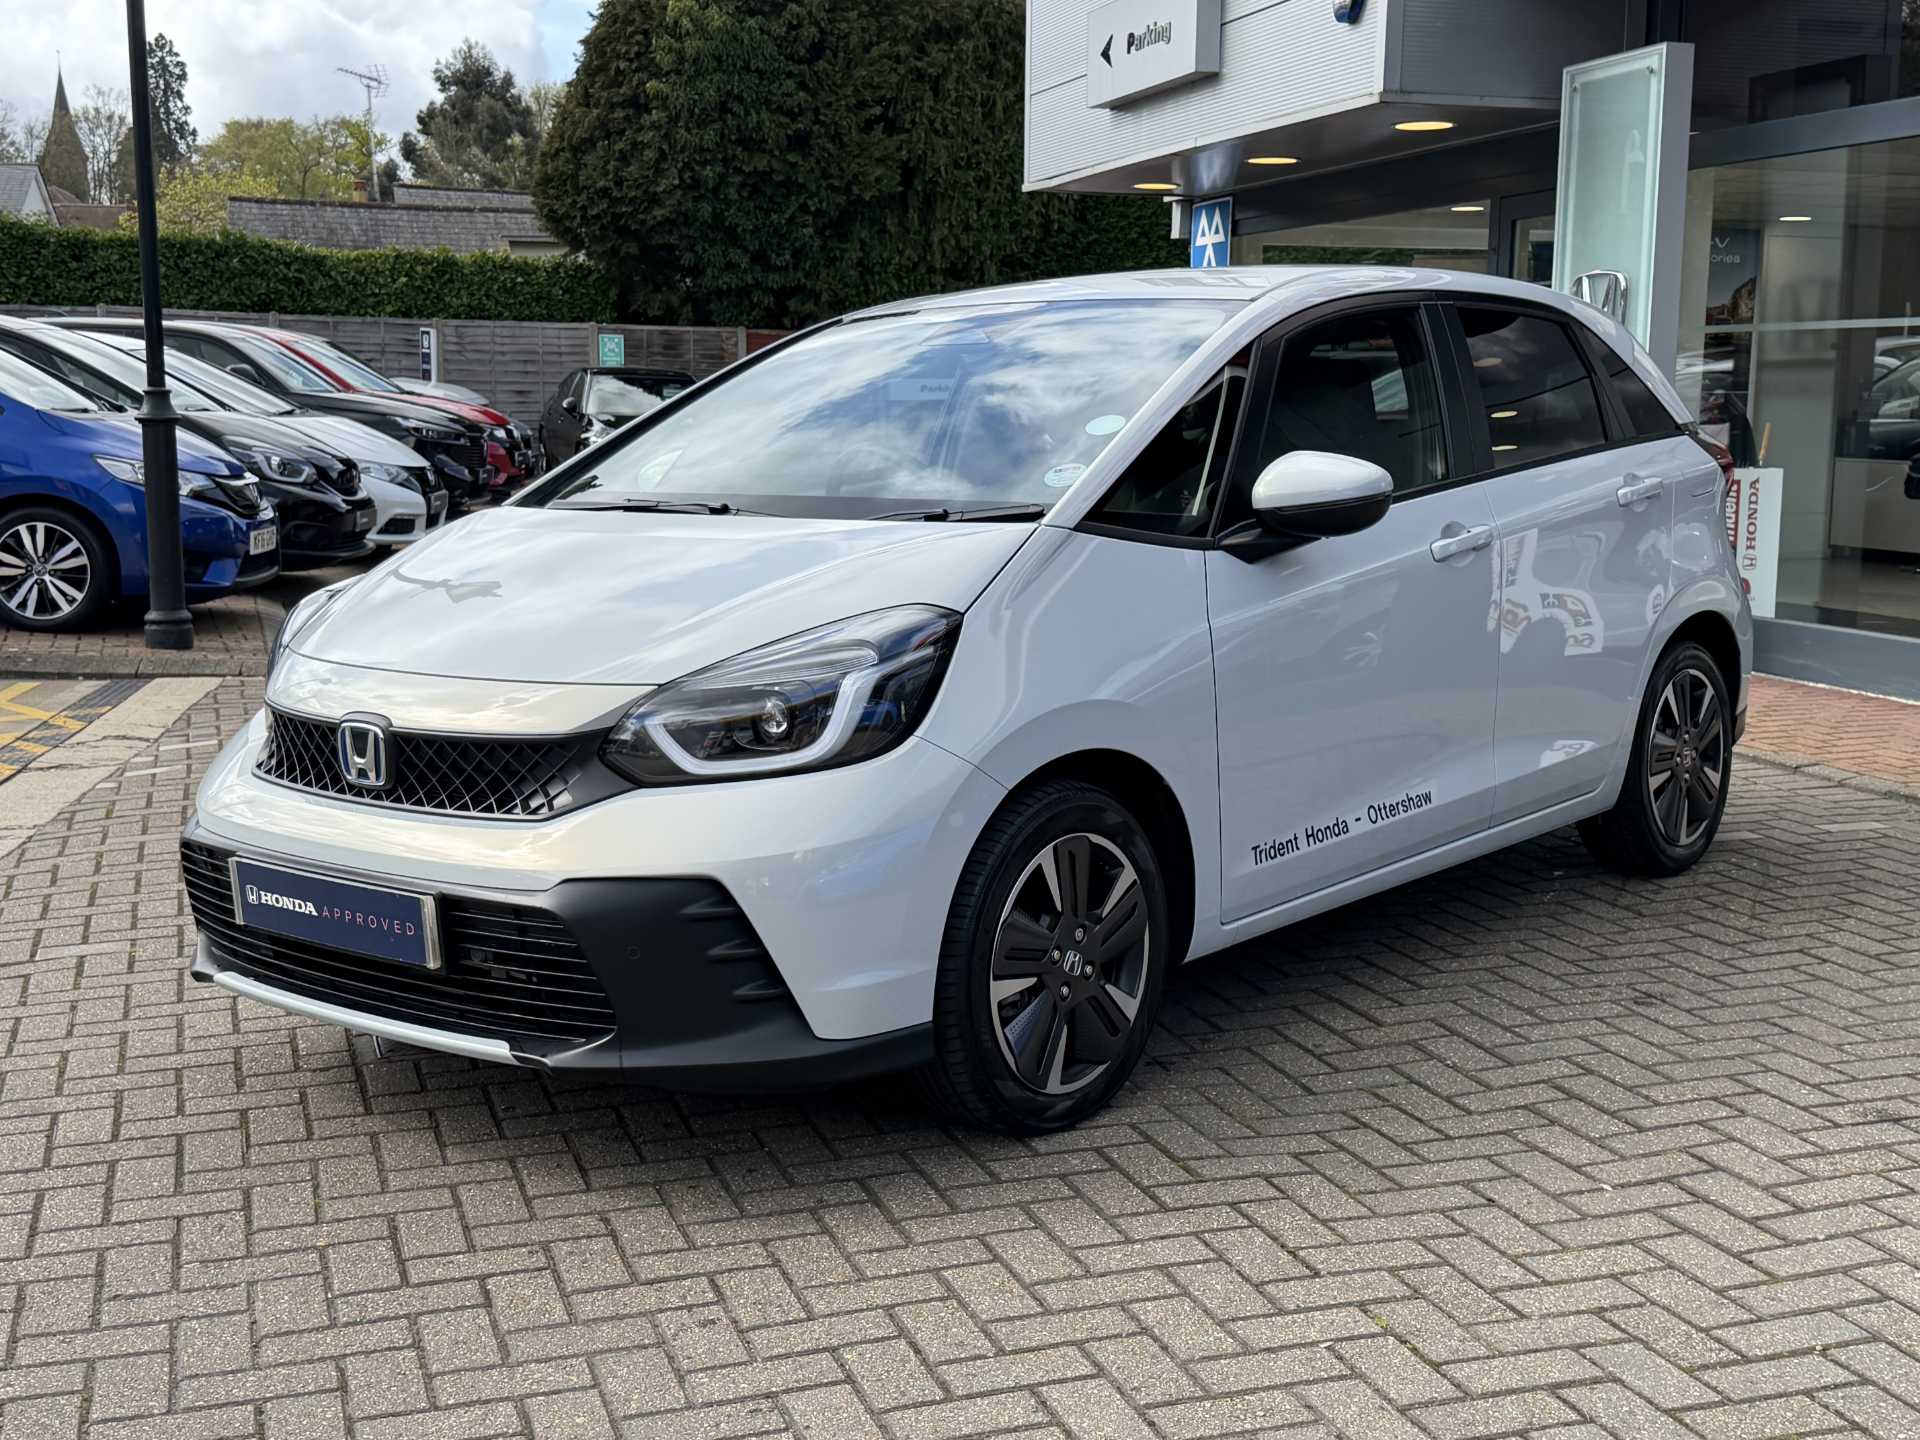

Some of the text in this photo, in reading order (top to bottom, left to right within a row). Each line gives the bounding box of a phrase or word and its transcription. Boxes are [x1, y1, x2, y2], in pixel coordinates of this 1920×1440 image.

[1126, 20, 1172, 55] Parking
[1746, 476, 1760, 551] HONDA
[1251, 832, 1300, 866] Trident
[1305, 816, 1350, 847] Honda
[1366, 789, 1433, 825] Ottershaw
[259, 890, 319, 917] HONDA
[322, 905, 416, 936] APPROVED
